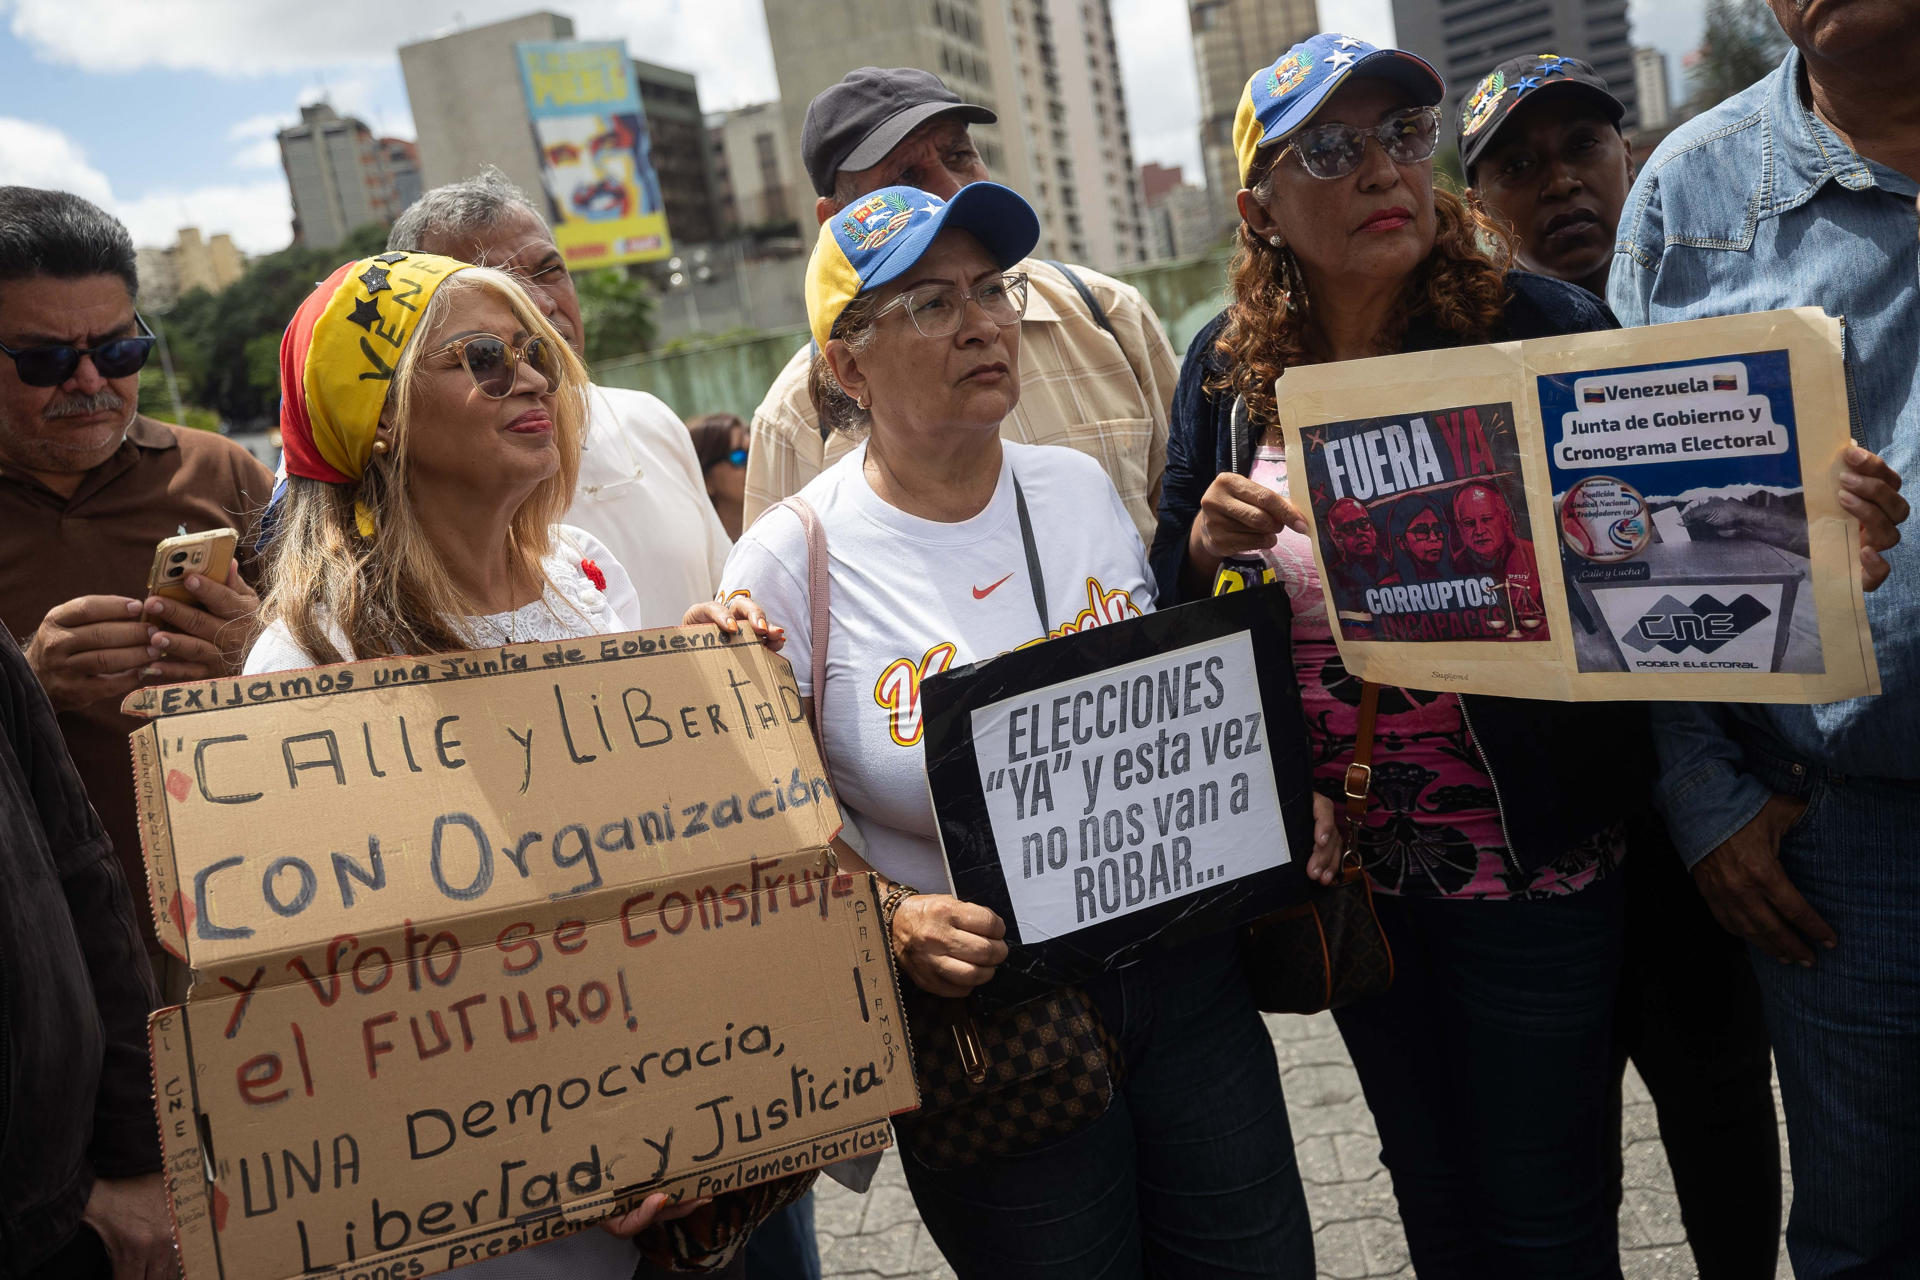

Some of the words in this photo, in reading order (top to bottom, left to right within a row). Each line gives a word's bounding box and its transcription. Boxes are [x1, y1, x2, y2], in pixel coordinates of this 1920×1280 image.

[1603, 377, 1709, 402] Venezuela
[1562, 441, 1678, 463] Cronograma
[1681, 429, 1776, 453] Electoral
[1570, 416, 1622, 436] Junta
[1625, 413, 1649, 431] de
[1652, 407, 1745, 428] Gobierno
[1748, 407, 1762, 423] y
[1323, 417, 1444, 501] FUERA
[1435, 407, 1497, 478] YA
[1600, 499, 1631, 507] Nacional
[1365, 576, 1498, 615] CORRUPTOS
[1637, 613, 1741, 641] CNE
[374, 665, 430, 686] una
[441, 648, 528, 680] Junta
[543, 645, 586, 665] de
[1636, 660, 1681, 669] PODER
[1683, 660, 1760, 670] ELECTORAL
[1008, 655, 1225, 764] ELECCIONES
[506, 725, 533, 796] y
[986, 750, 1073, 821] "YA"
[1081, 755, 1104, 815] y
[1113, 728, 1192, 792] esta
[1201, 711, 1263, 766] vez
[194, 833, 387, 940] CON
[430, 767, 834, 902] Organización
[1021, 825, 1068, 880] no
[1079, 803, 1146, 862] nos
[1153, 779, 1219, 837] van
[1229, 771, 1250, 815] a
[1073, 835, 1226, 924] ROBAR...
[235, 1022, 314, 1109] el
[362, 967, 639, 1080] FUTURO!
[406, 1022, 785, 1160] Democracia,
[643, 1126, 674, 1180] y
